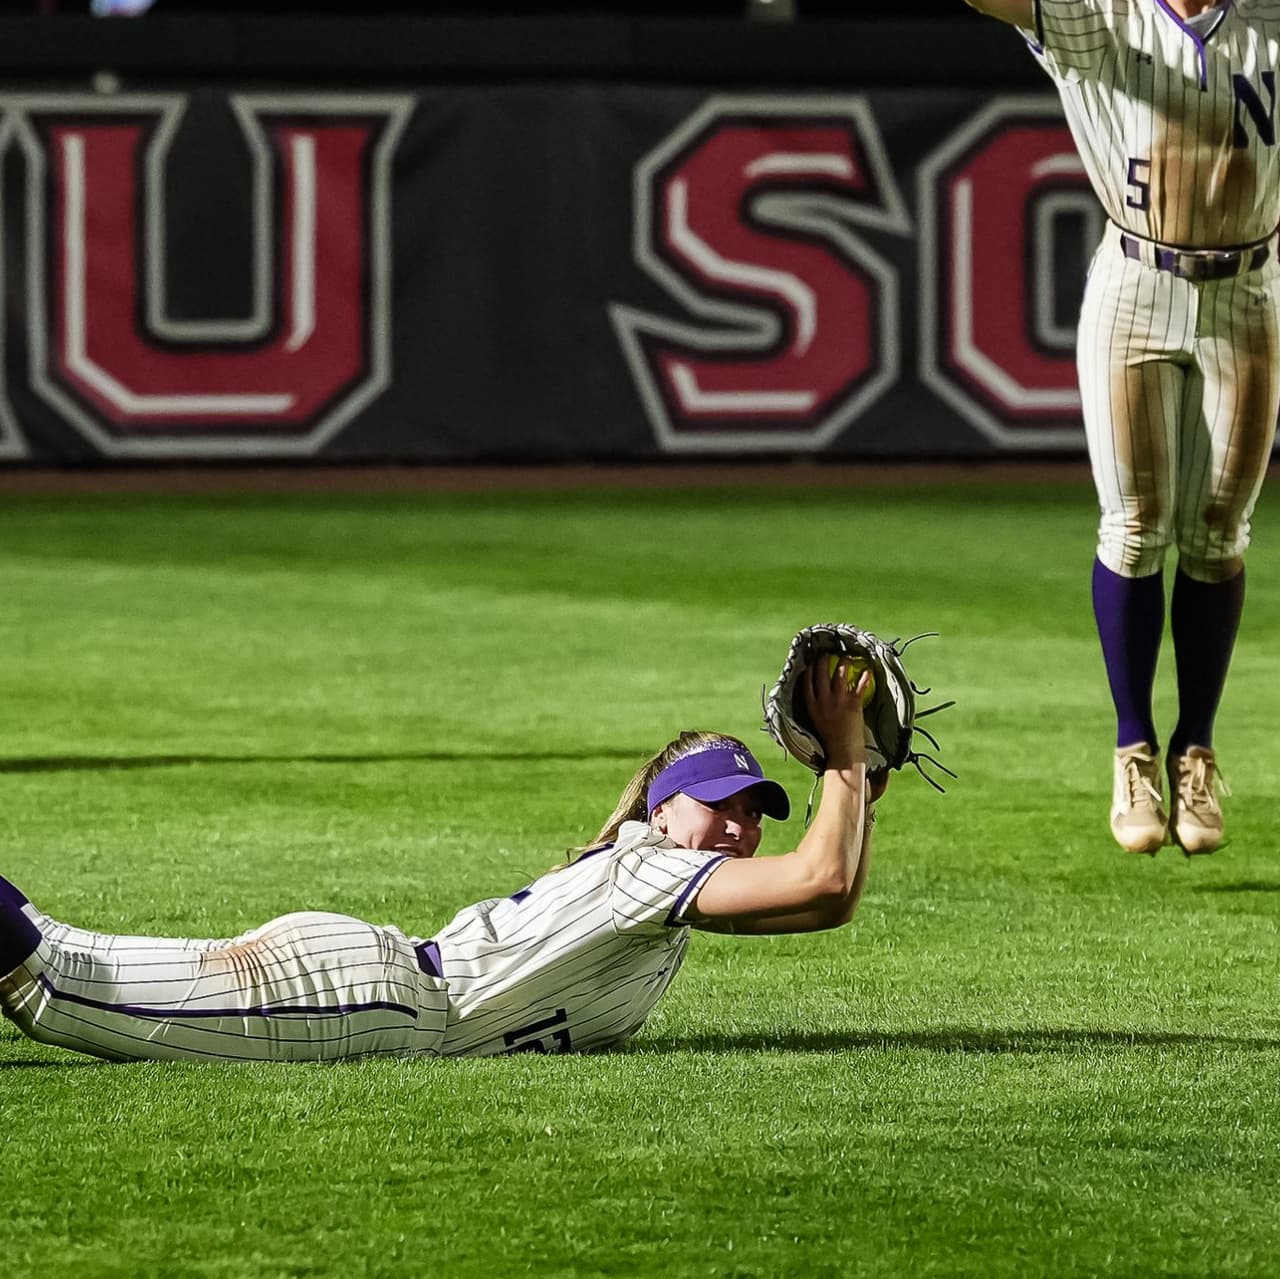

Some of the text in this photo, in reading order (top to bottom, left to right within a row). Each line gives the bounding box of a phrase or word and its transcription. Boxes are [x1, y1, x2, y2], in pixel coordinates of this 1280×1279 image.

[1232, 71, 1276, 149] N
[1126, 157, 1152, 212] 5
[733, 752, 750, 771] N
